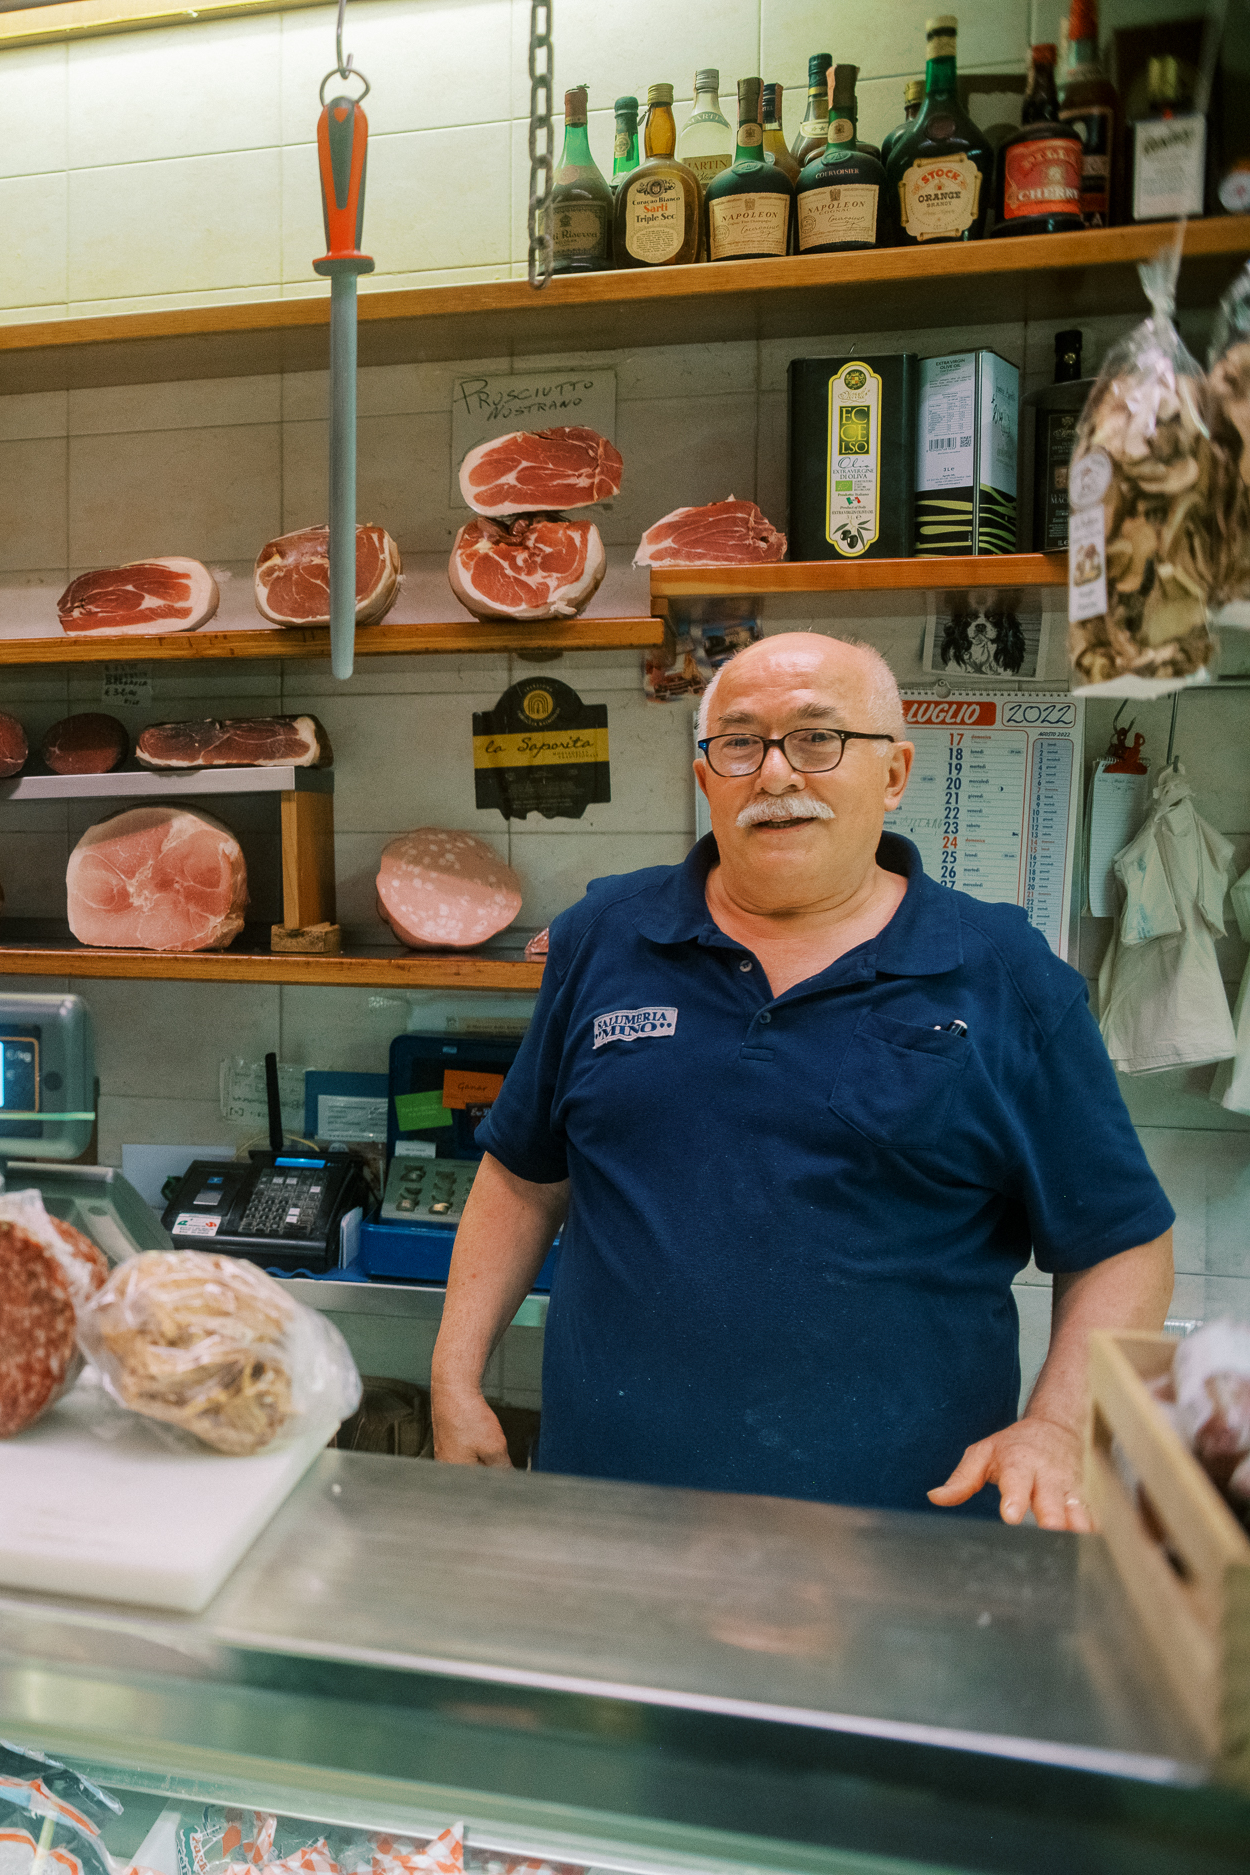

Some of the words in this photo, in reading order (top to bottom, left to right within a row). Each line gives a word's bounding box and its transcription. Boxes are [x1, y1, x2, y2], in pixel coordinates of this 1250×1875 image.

[815, 168, 860, 179] COURVOISIER
[921, 168, 961, 185] STOCK
[917, 190, 962, 203] ORANGE
[643, 202, 668, 214] Sarti
[807, 200, 866, 214] NAPOLEON
[636, 214, 659, 224] Triple
[660, 213, 676, 221] Sec
[721, 211, 778, 223] NAPOLEON
[454, 378, 594, 415] PROSCIUTTO
[906, 703, 980, 724] LUGLIO
[1006, 704, 1074, 725] 2022
[950, 732, 964, 746] 17
[486, 740, 506, 754] la
[517, 736, 594, 758] Saporita
[949, 748, 964, 760] 18
[948, 762, 962, 776] 19
[946, 777, 962, 790] 20
[945, 792, 960, 804] 21
[944, 806, 960, 820] 22
[943, 821, 959, 834] 23
[942, 836, 958, 849] 24
[942, 850, 957, 864] 25
[940, 866, 956, 878] 26
[598, 1012, 668, 1030] SALUMERIA
[602, 1022, 658, 1040] MINO
